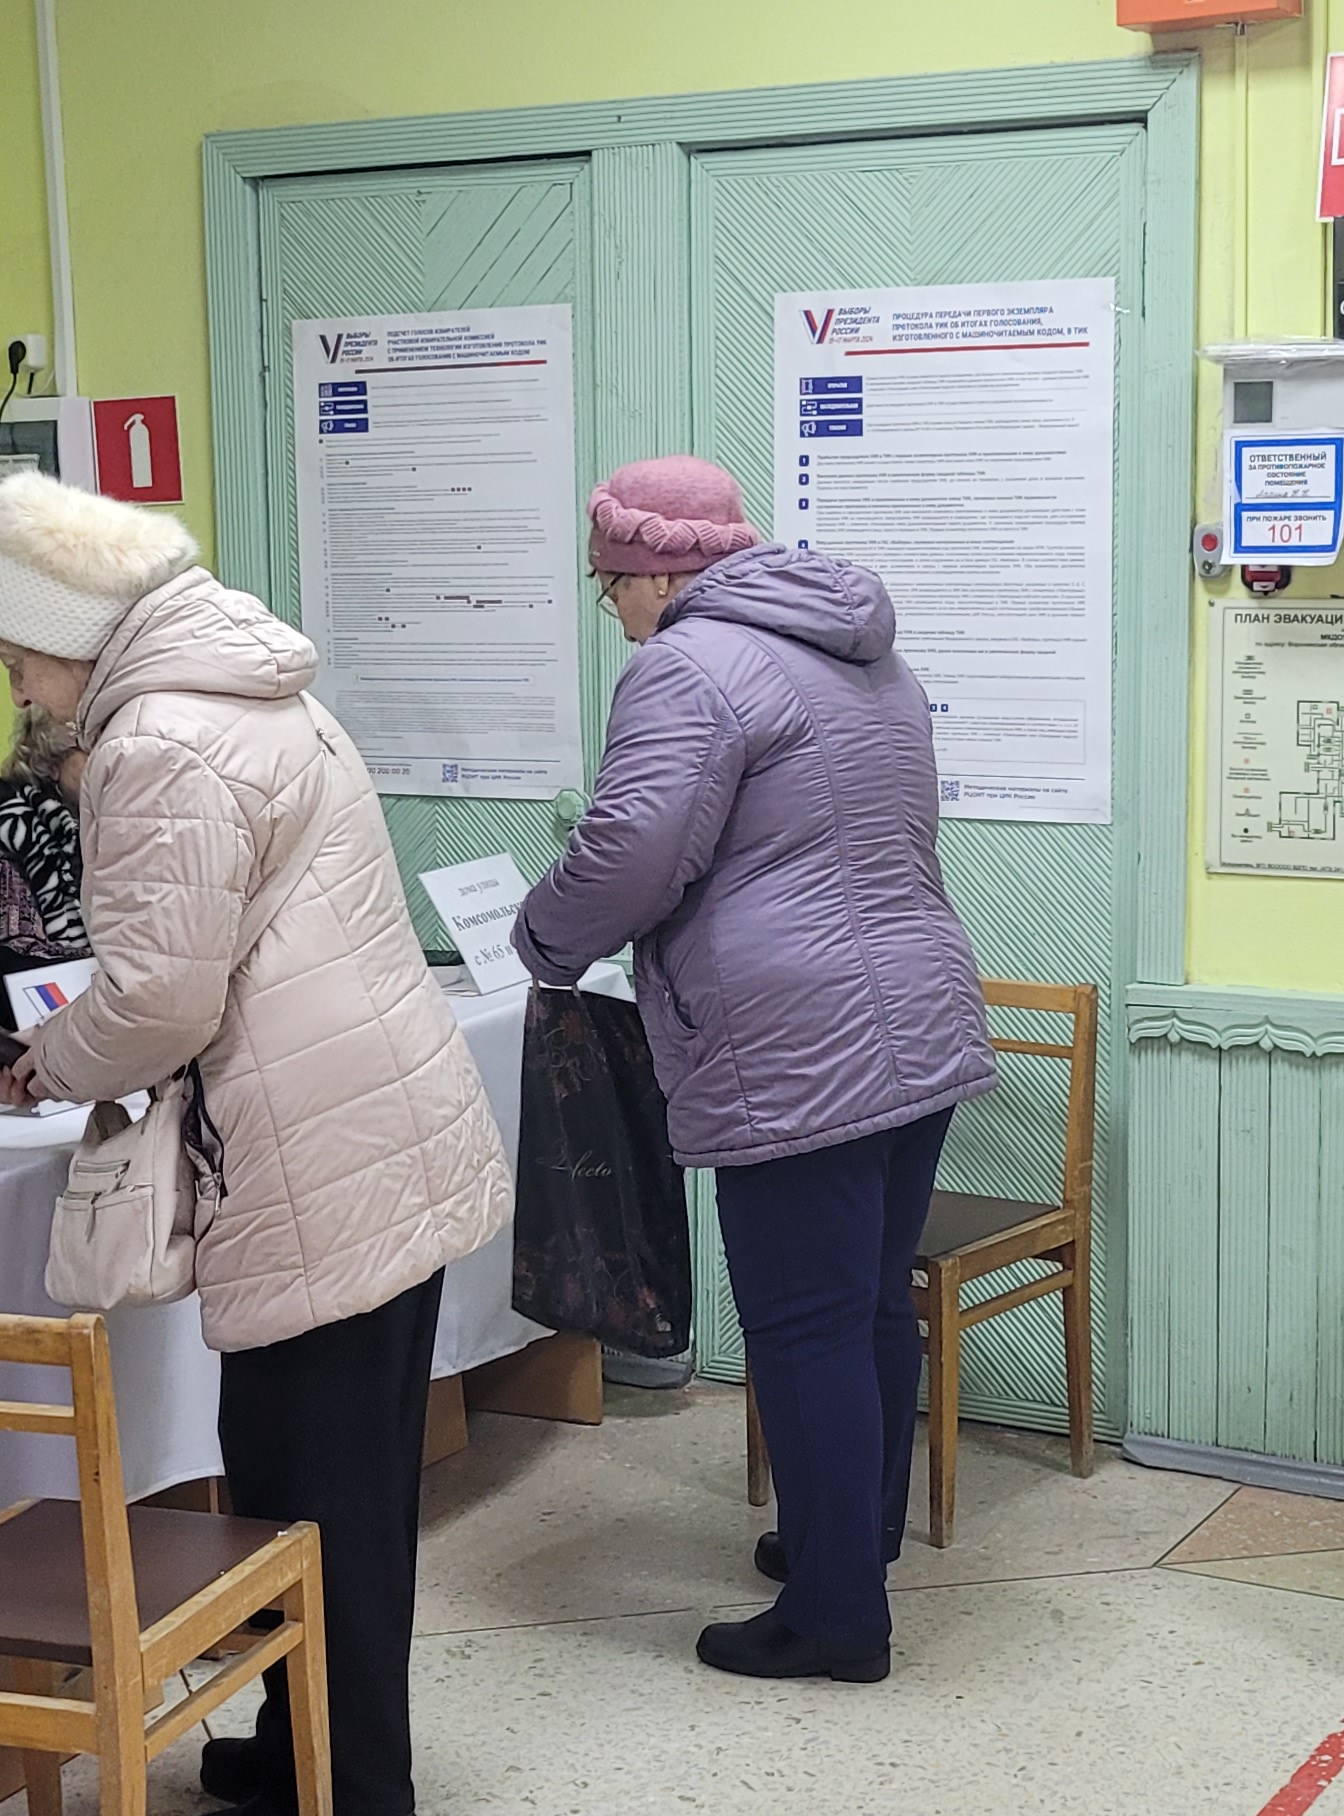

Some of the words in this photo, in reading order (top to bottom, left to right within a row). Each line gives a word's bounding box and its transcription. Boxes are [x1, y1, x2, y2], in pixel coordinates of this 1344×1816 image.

[838, 306, 871, 316] ВЫБОРЫ
[892, 312, 933, 321] ПРОЦЕДУРА
[935, 310, 971, 319] ПЕРЕДАЧИ
[973, 307, 1005, 317] ПЕРВОГО
[1006, 306, 1054, 316] ЭКЗЕМПЛЯРА
[835, 316, 880, 326] ПРЕЗИДЕНТА
[892, 321, 933, 331] ПРОТОКОЛА
[950, 321, 959, 329] ОБ
[961, 320, 988, 328] ИТОГАХ
[831, 327, 861, 336] РОССИИ
[892, 331, 953, 341] ИЗГОТОВЛЕННОГО
[962, 328, 1035, 338] МАШИНОЧИТАЕМЫМ
[1074, 326, 1088, 335] ТИК
[1249, 452, 1327, 463] ОТВЕТСТВЕННЫЙ
[1268, 523, 1303, 543] 101
[1234, 613, 1270, 624] ПЛАН
